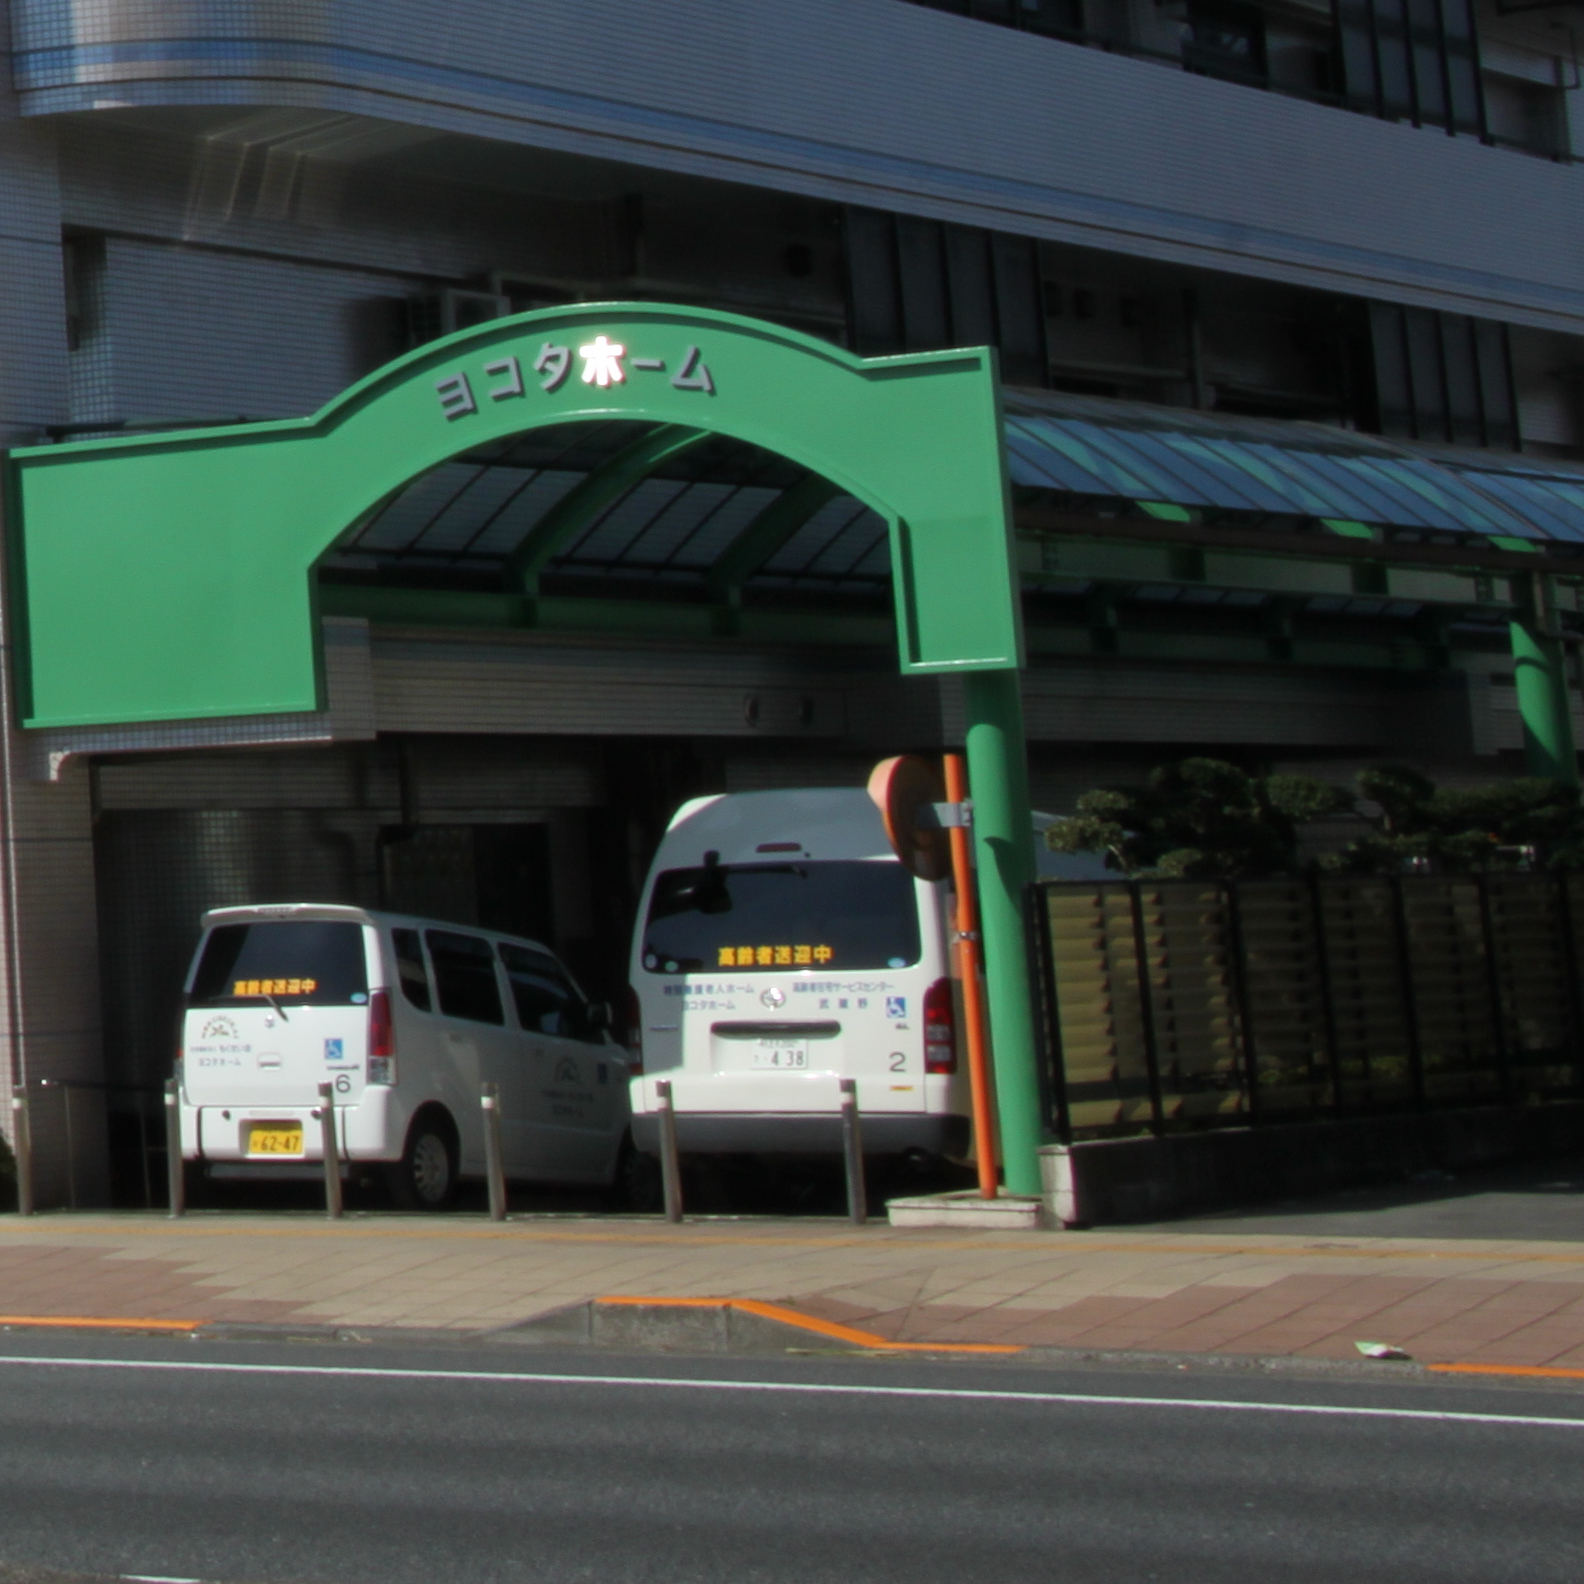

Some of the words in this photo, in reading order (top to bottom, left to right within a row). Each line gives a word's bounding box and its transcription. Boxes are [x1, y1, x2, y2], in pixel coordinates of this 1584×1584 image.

[436, 335, 716, 421] ヨコタホーム
[718, 944, 832, 967] 高齢者送迎中
[889, 1051, 906, 1073] 2
[335, 1074, 351, 1093] 6
[261, 1135, 300, 1152] 62-47
